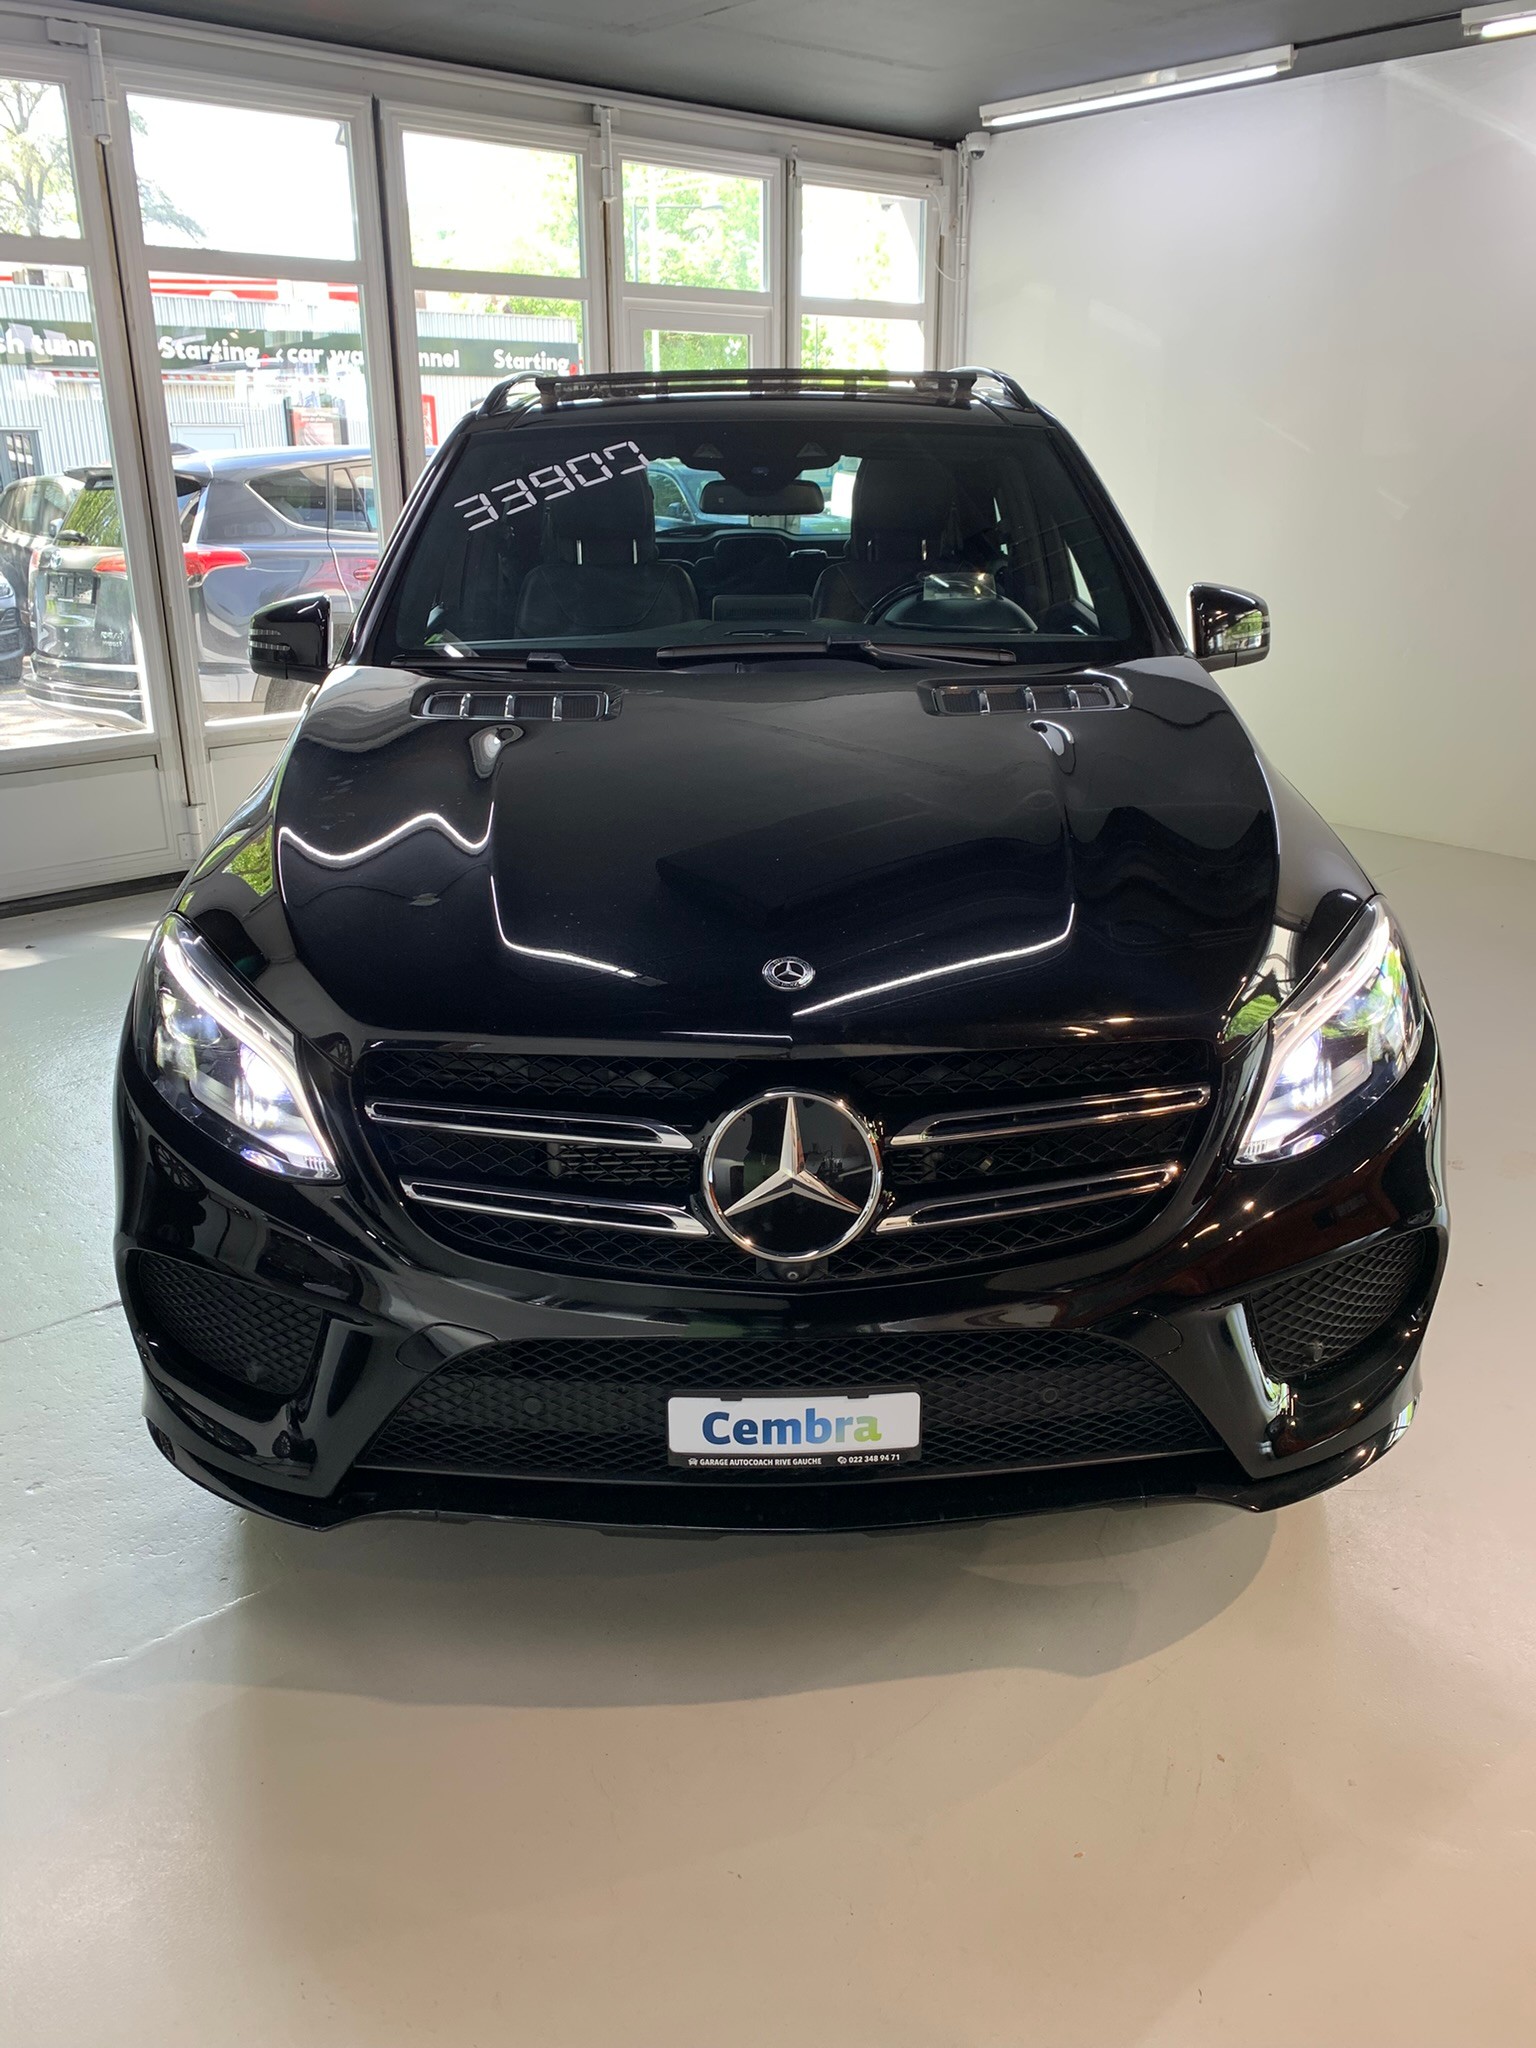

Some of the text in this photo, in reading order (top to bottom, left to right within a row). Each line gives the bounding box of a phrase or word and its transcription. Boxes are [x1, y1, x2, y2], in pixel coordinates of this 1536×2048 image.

[287, 347, 324, 364] car
[702, 1407, 883, 1446] Cembra
[699, 1457, 822, 1466] GARAGE AUTOCOACH RIVE GAUCHE
[848, 1453, 900, 1464] 022 348 94 71
